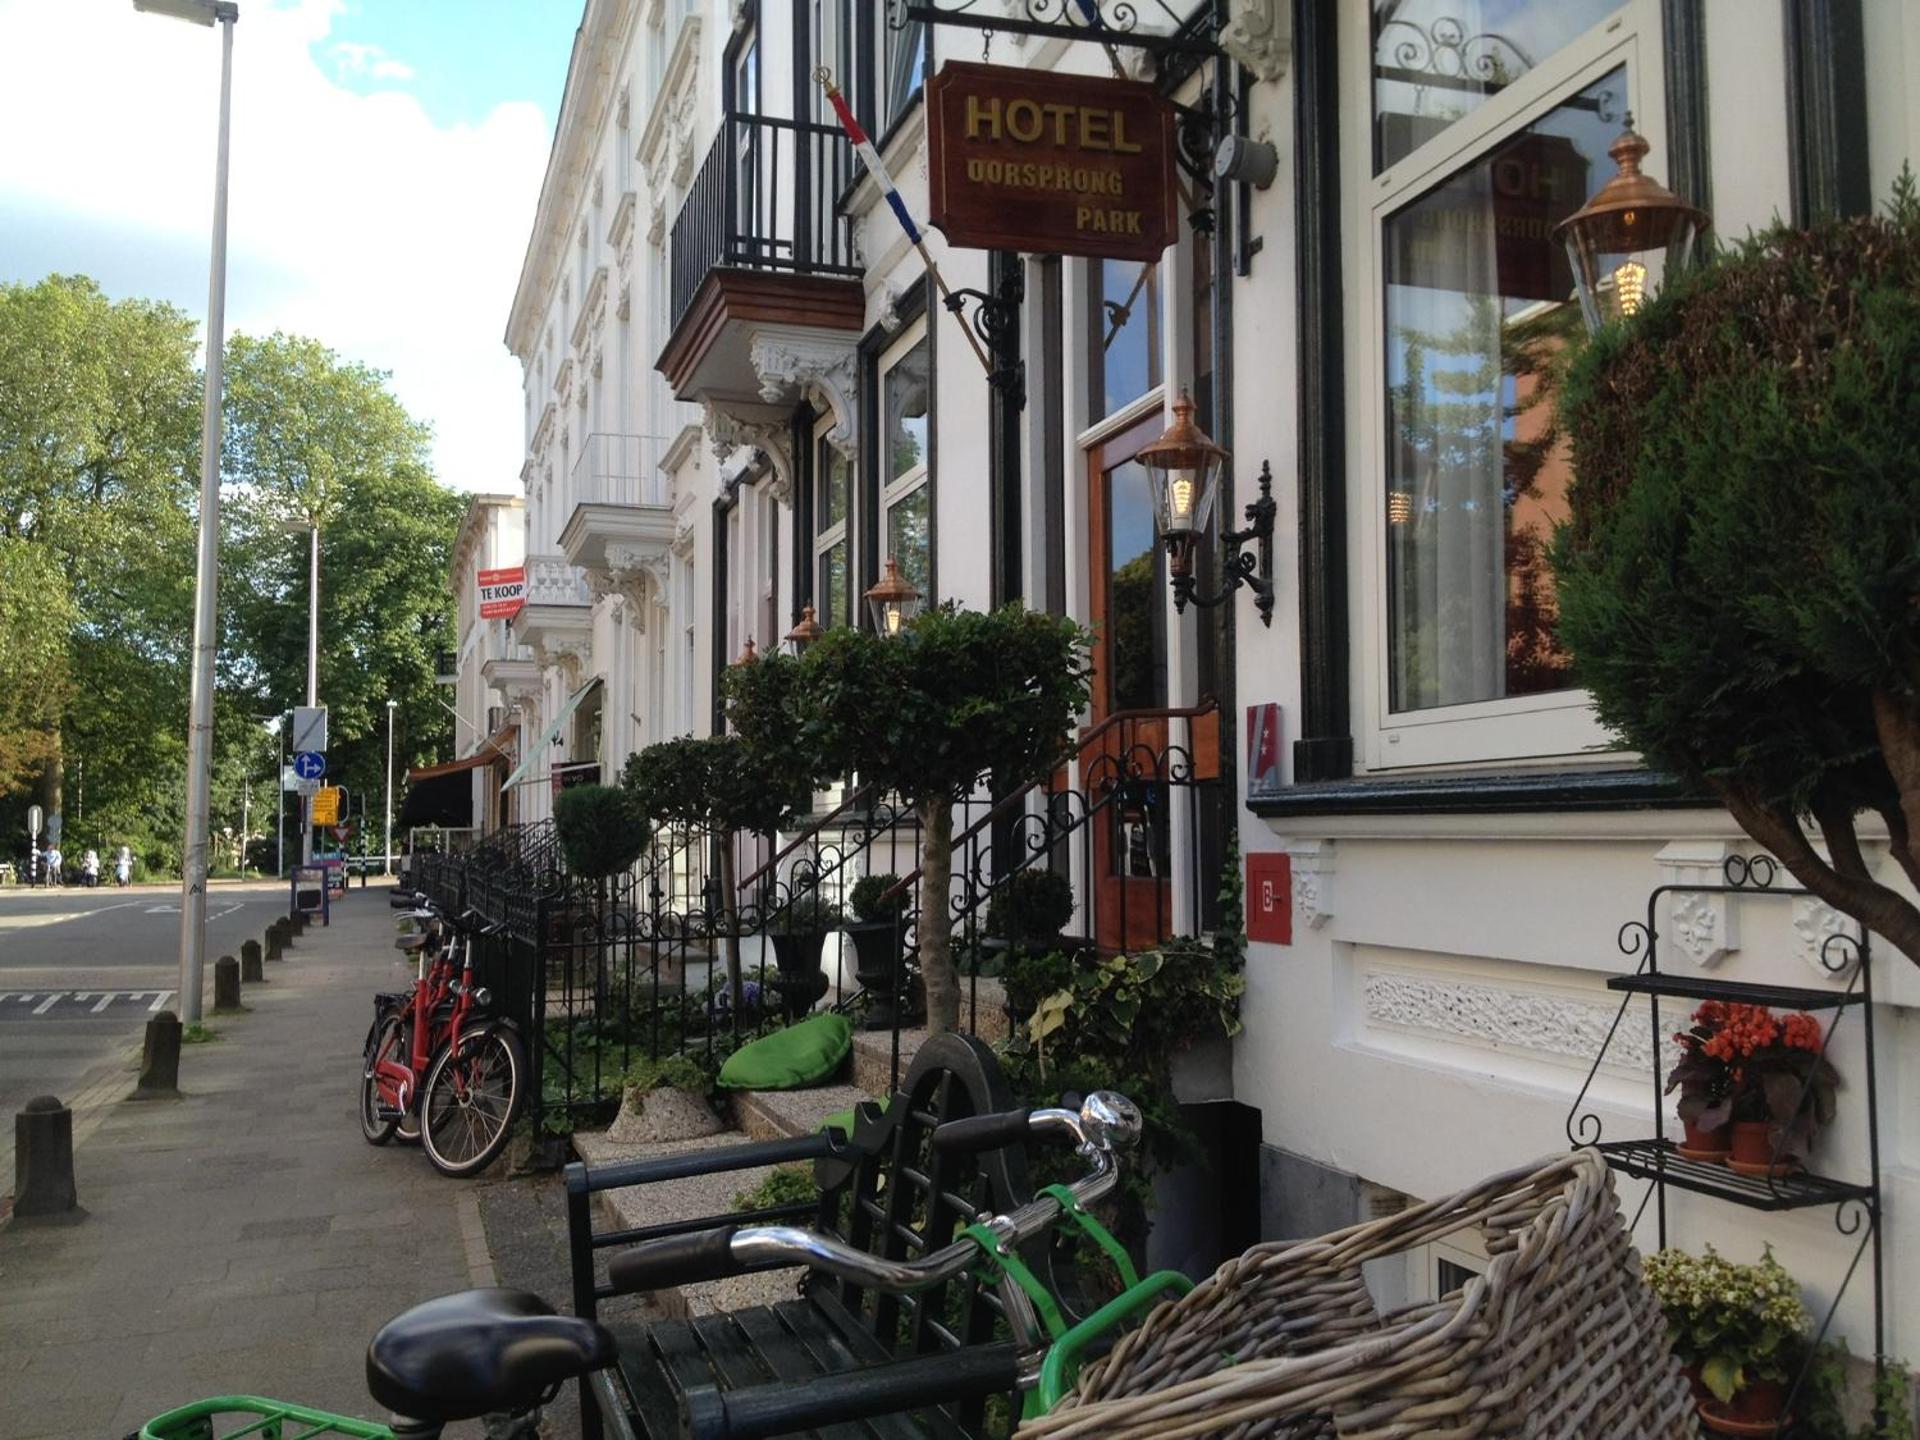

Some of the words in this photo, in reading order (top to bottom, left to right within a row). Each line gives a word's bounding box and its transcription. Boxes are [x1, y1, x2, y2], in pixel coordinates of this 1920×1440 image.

[965, 95, 1142, 153] HOTEL
[967, 158, 1123, 195] OORSPRONG
[1076, 206, 1142, 233] PARK
[481, 588, 492, 600] TE
[494, 584, 523, 598] KOOP
